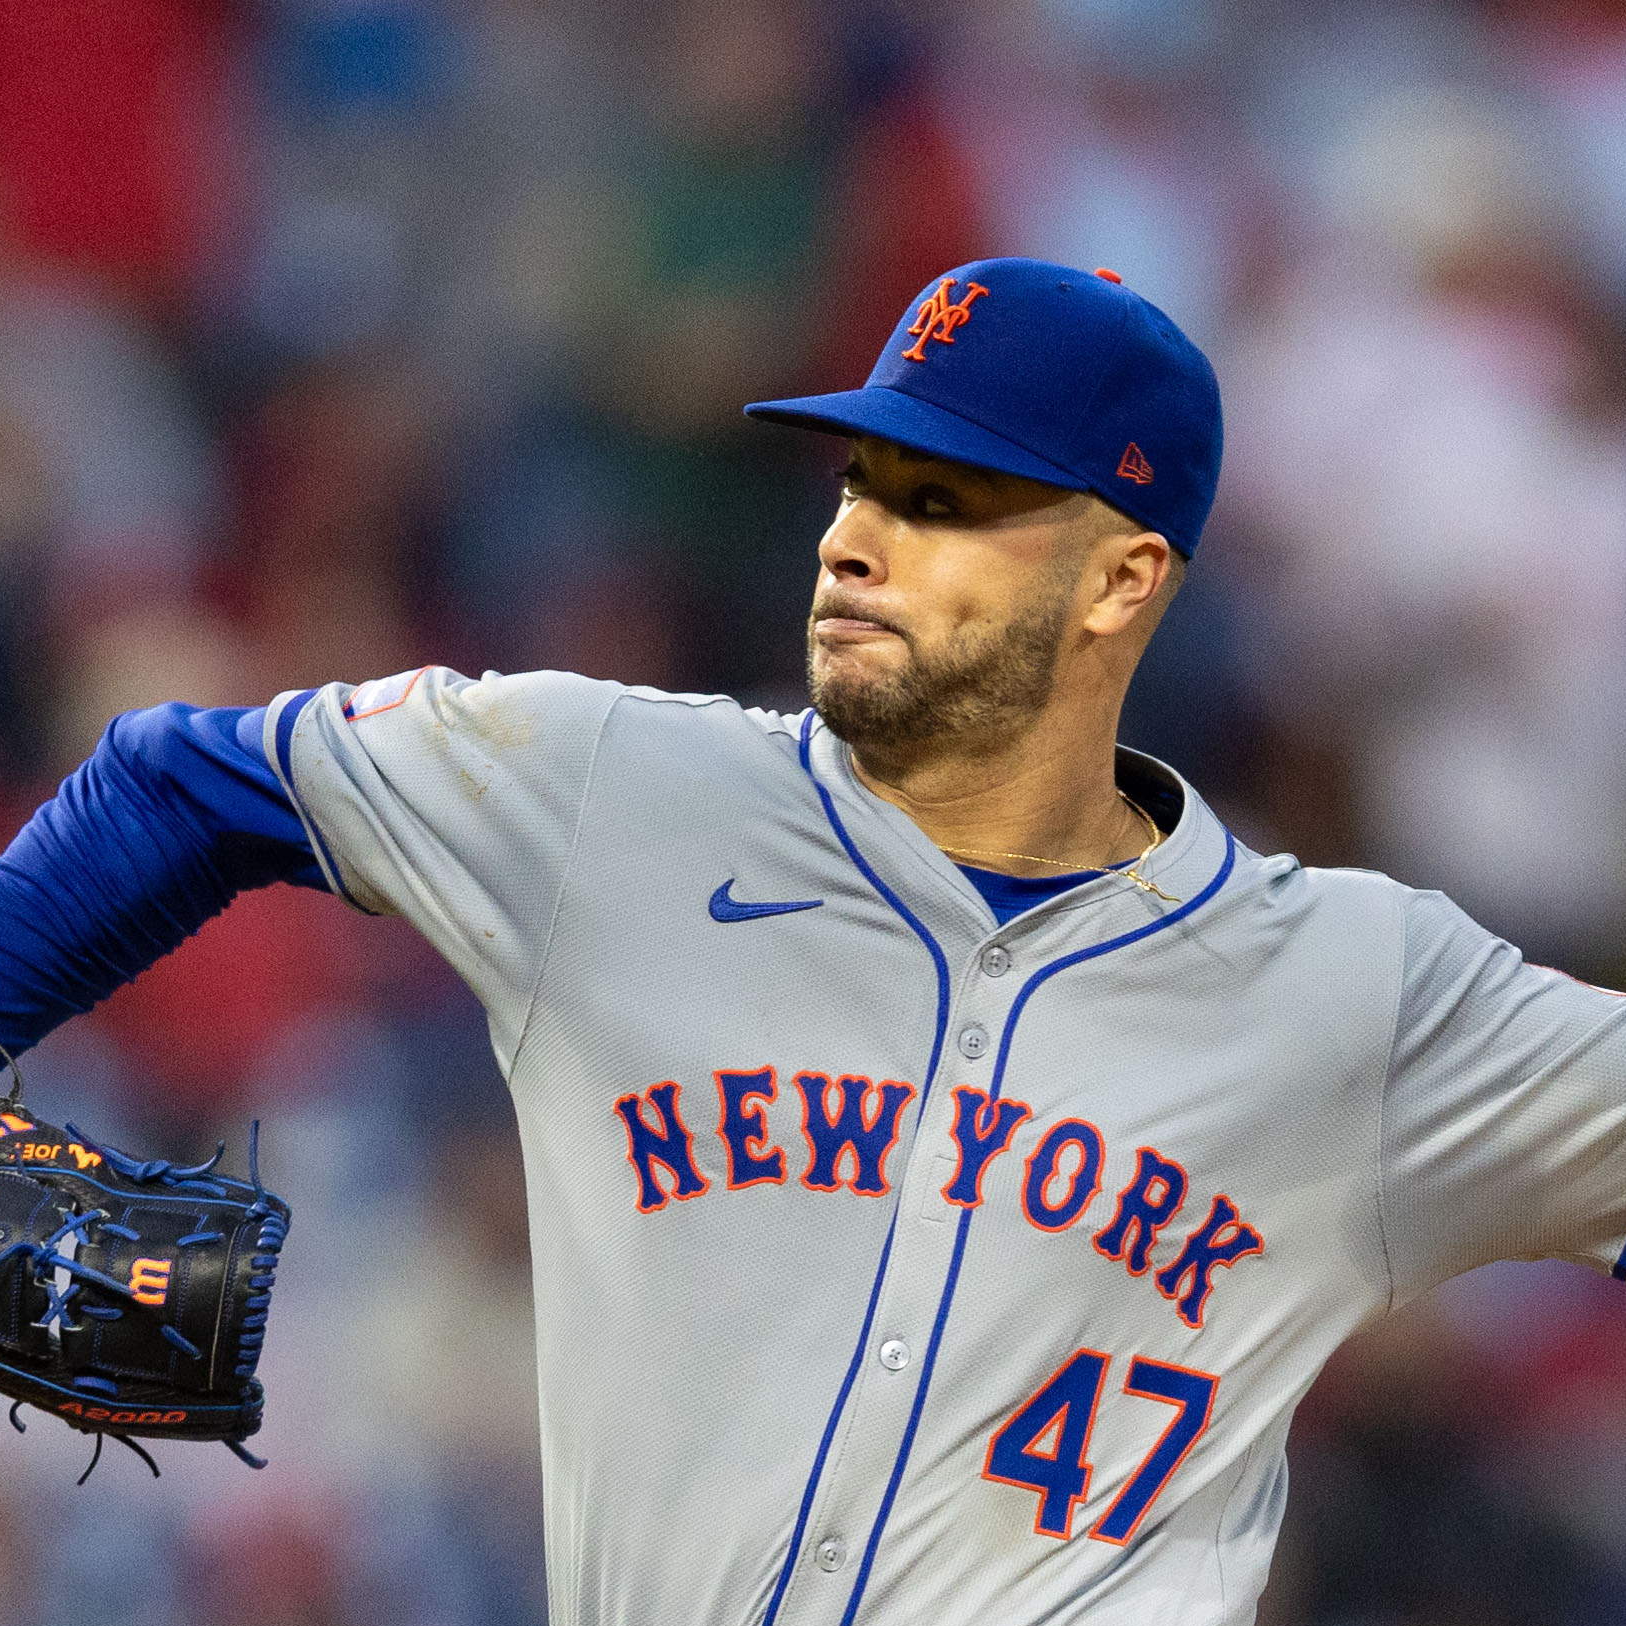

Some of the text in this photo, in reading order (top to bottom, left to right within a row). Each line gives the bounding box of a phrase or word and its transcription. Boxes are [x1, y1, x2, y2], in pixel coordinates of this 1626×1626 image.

[614, 1064, 1265, 1329] NEW YORK
[58, 1401, 187, 1424] A2000
[981, 1347, 1221, 1548] 47
